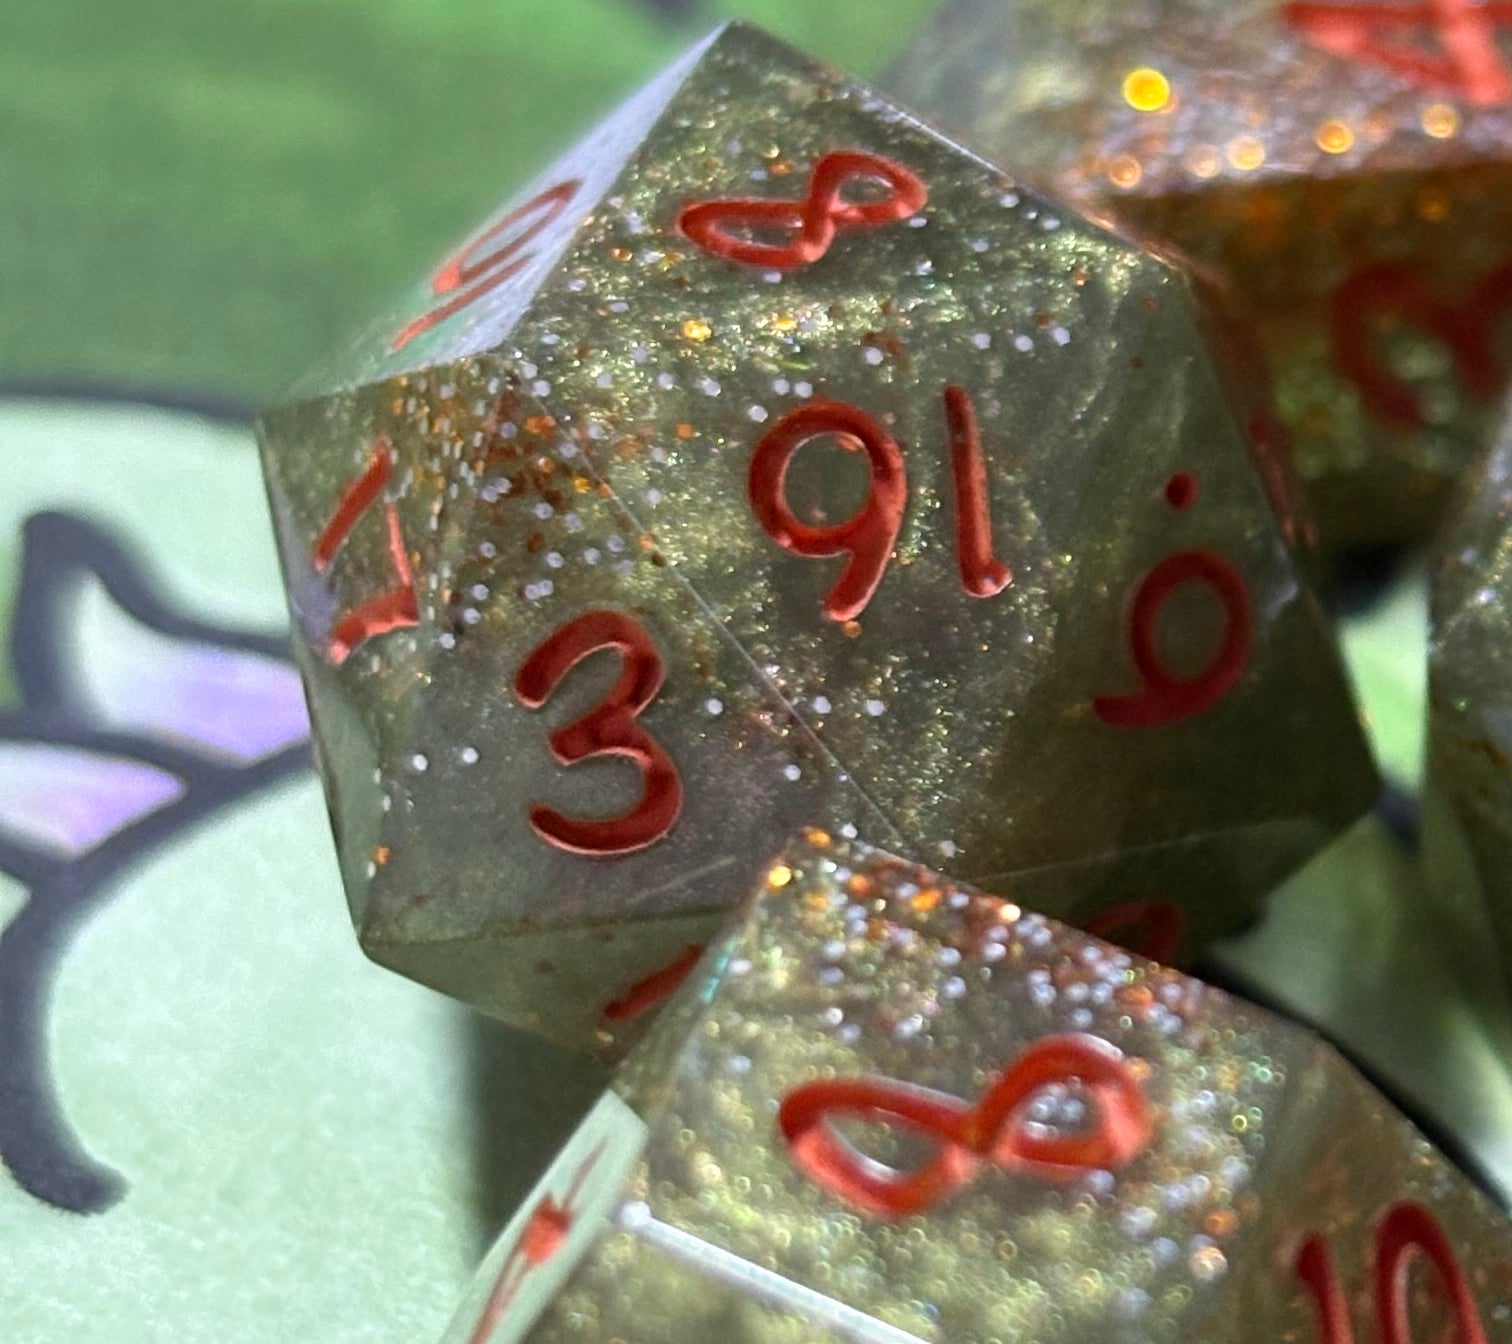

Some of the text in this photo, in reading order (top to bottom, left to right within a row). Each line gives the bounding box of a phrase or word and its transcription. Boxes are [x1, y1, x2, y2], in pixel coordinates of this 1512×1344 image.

[679, 149, 928, 271] 8
[515, 610, 684, 855] 3
[778, 1032, 1156, 1222] 8
